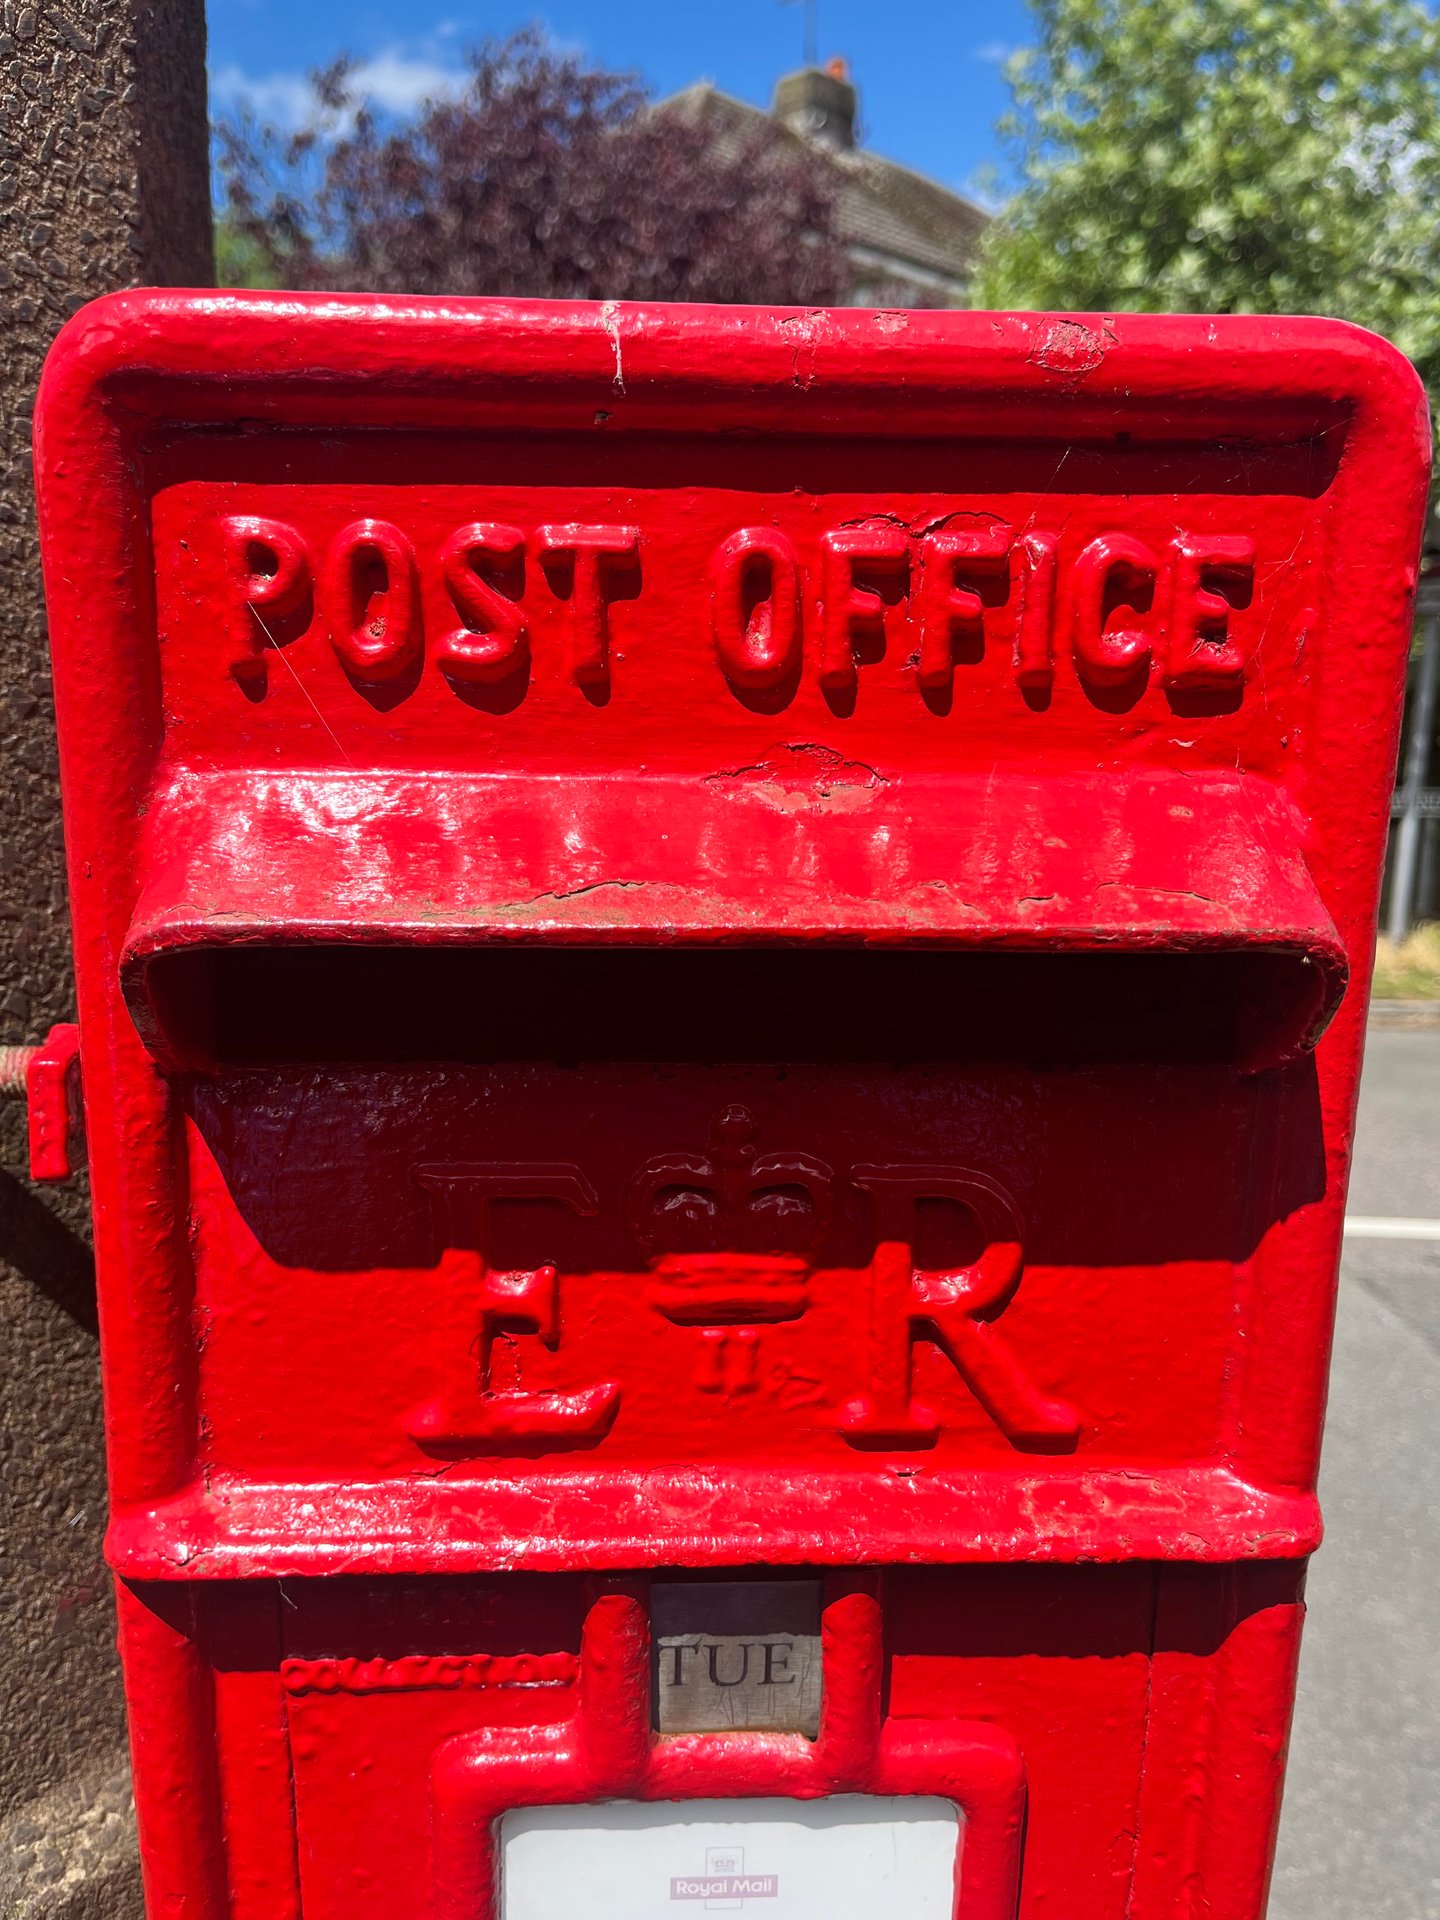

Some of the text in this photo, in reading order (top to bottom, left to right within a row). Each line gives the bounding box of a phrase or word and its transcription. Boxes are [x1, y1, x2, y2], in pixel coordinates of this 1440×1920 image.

[222, 514, 1256, 690] POST OFFICE
[412, 1160, 1082, 1440] E R
[658, 1642, 797, 1687] TUE
[676, 1878, 772, 1897] Royal Mail
